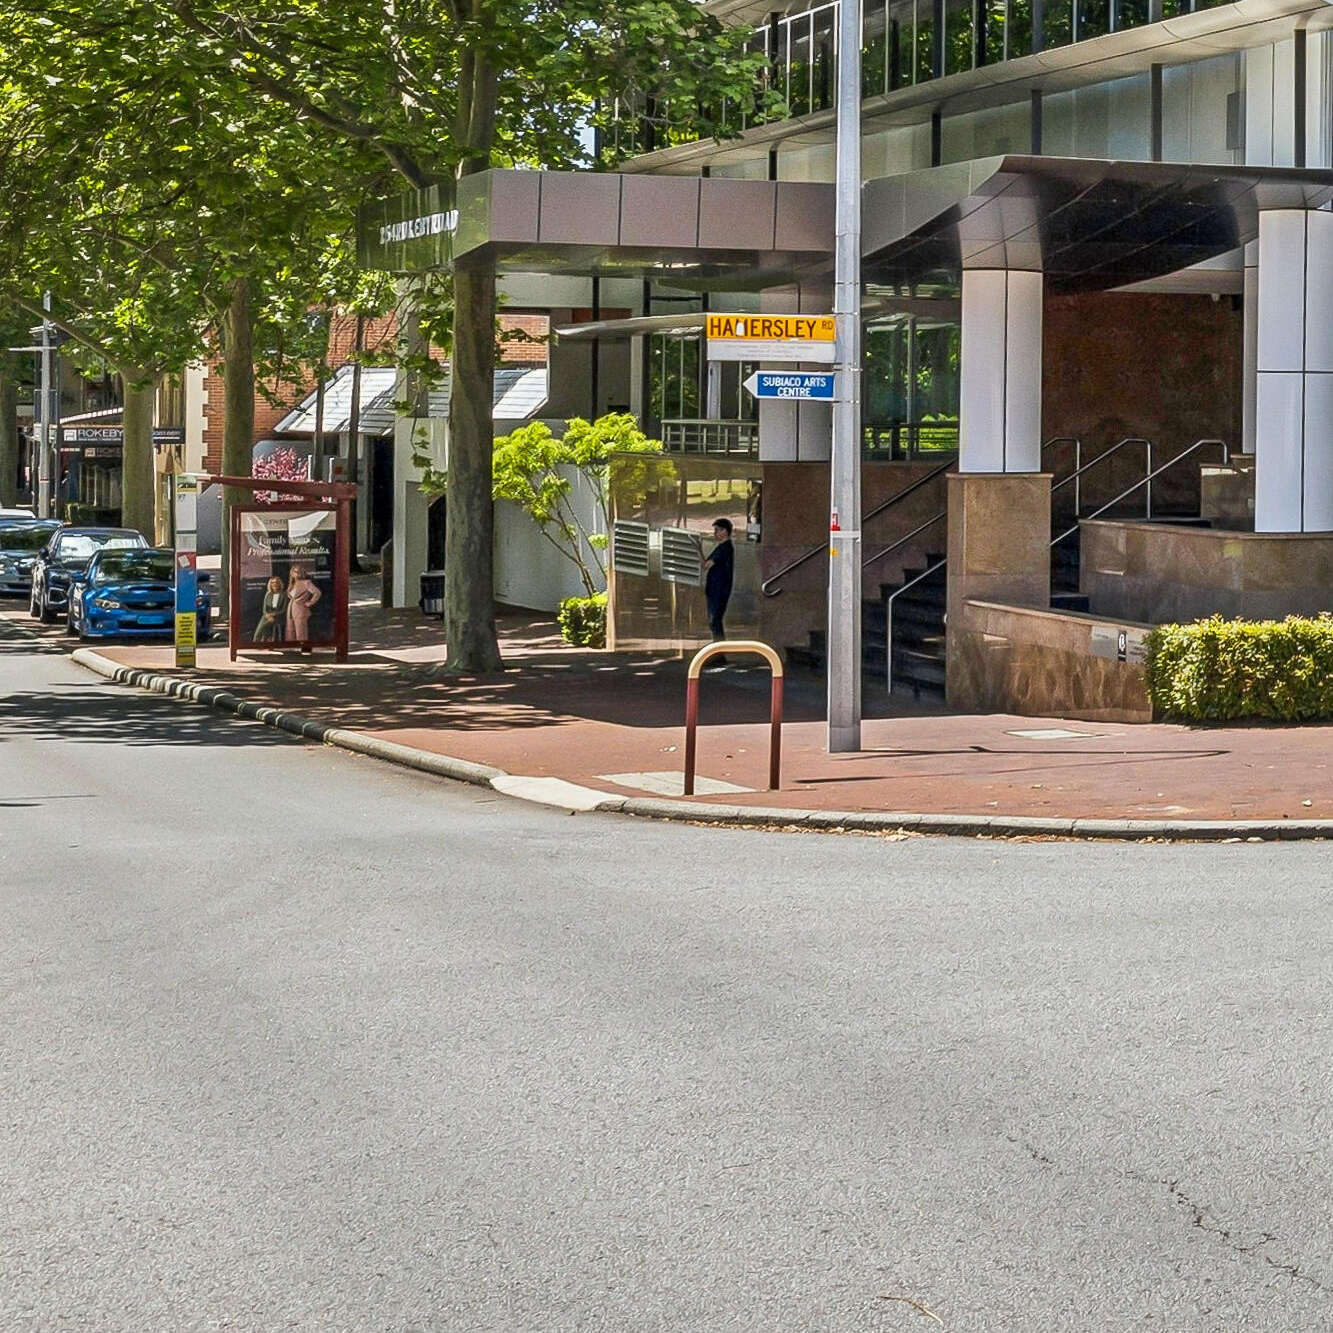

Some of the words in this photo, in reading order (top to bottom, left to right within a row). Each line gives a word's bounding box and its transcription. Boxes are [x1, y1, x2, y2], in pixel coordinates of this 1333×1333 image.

[710, 317, 817, 338] HAMERSLEY
[822, 320, 834, 331] RD
[762, 376, 802, 387] SUBIACO
[803, 377, 827, 387] ARTS
[777, 387, 812, 397] CENTRE
[78, 429, 124, 437] ROKEBY
